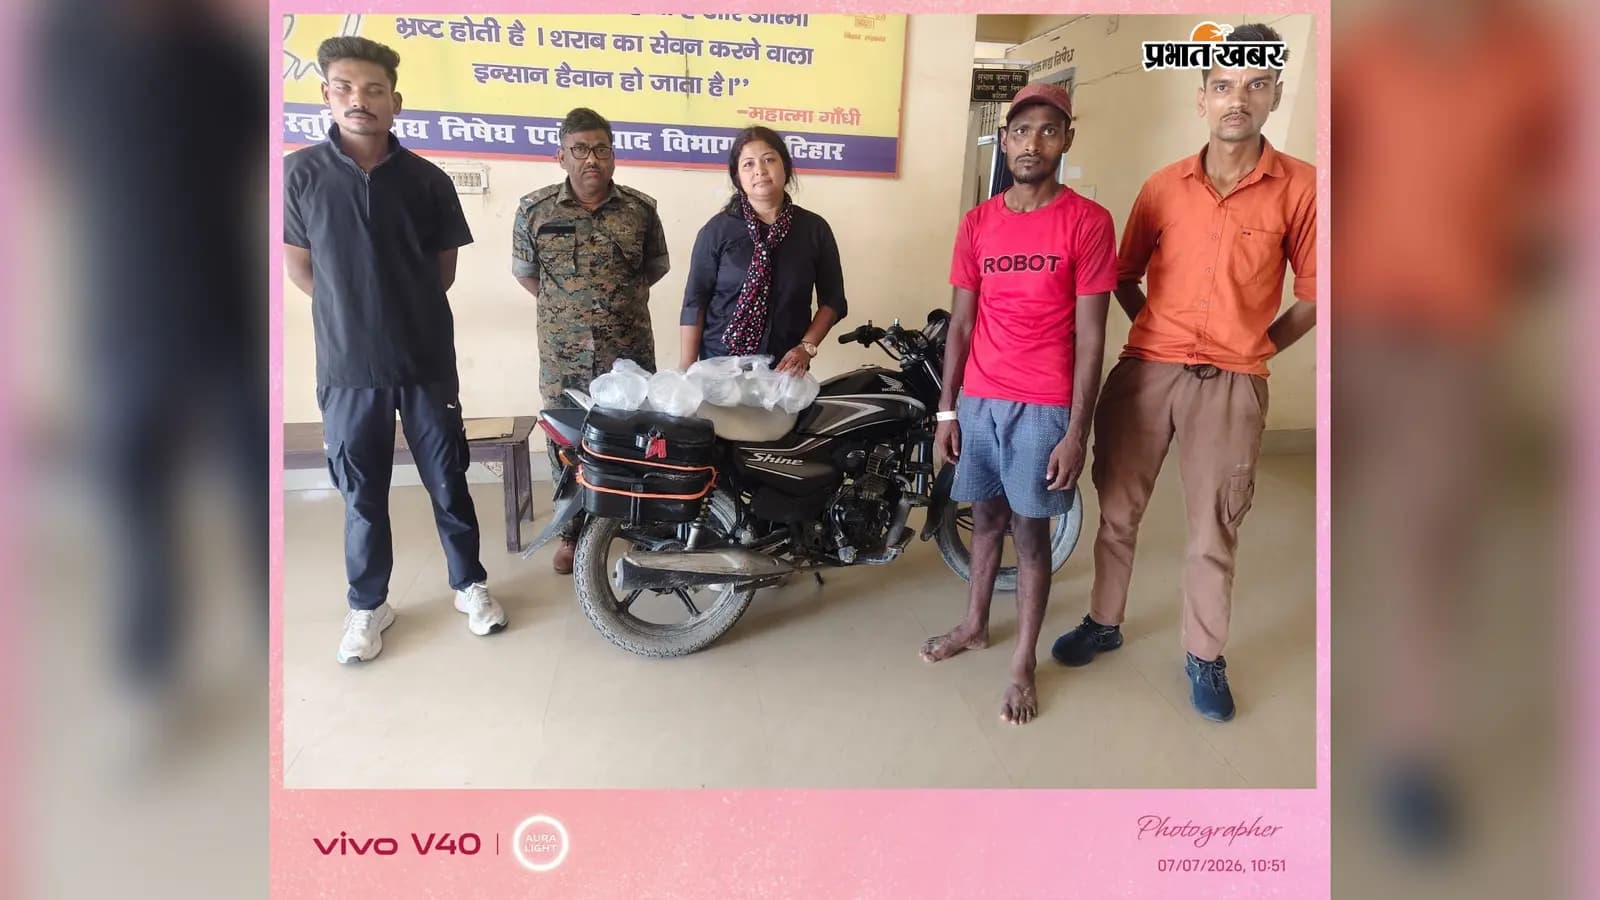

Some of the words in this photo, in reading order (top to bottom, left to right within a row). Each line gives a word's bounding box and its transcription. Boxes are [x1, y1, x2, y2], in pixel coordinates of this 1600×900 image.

[396, 16, 444, 39] भ्रष्ट
[450, 16, 500, 42] होती
[507, 19, 526, 46] है
[550, 29, 606, 50] शराब
[613, 33, 643, 52] का
[650, 30, 704, 56] सेवन
[709, 37, 761, 61] करने
[766, 44, 814, 65] वाला
[472, 63, 548, 85] इन्सान
[555, 61, 613, 88] हैवान
[620, 66, 643, 91] हो
[649, 74, 703, 94] जाता
[783, 135, 846, 161] टिहार
[983, 254, 1062, 275] ROBOT
[747, 452, 804, 466] Shine
